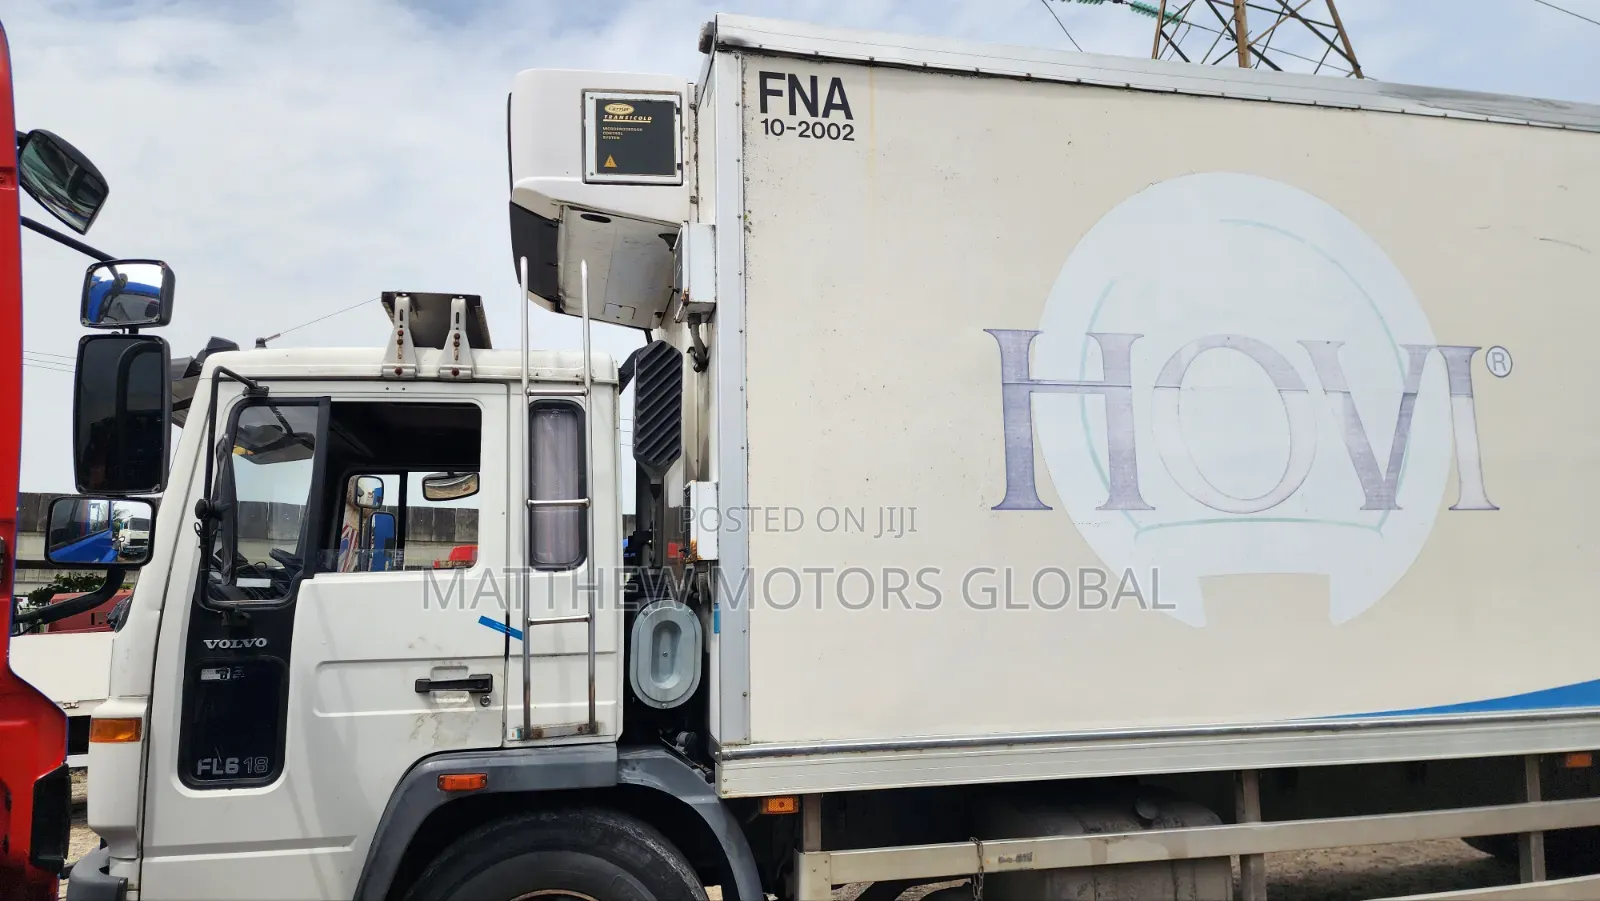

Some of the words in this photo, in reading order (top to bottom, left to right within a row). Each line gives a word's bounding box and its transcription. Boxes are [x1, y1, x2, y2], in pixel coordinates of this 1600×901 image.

[759, 70, 854, 120] FNA
[760, 118, 855, 142] 10-2002
[983, 328, 1500, 514] HOVI
[203, 638, 268, 649] VOLVO
[196, 757, 240, 776] FL6
[243, 756, 269, 774] 18
